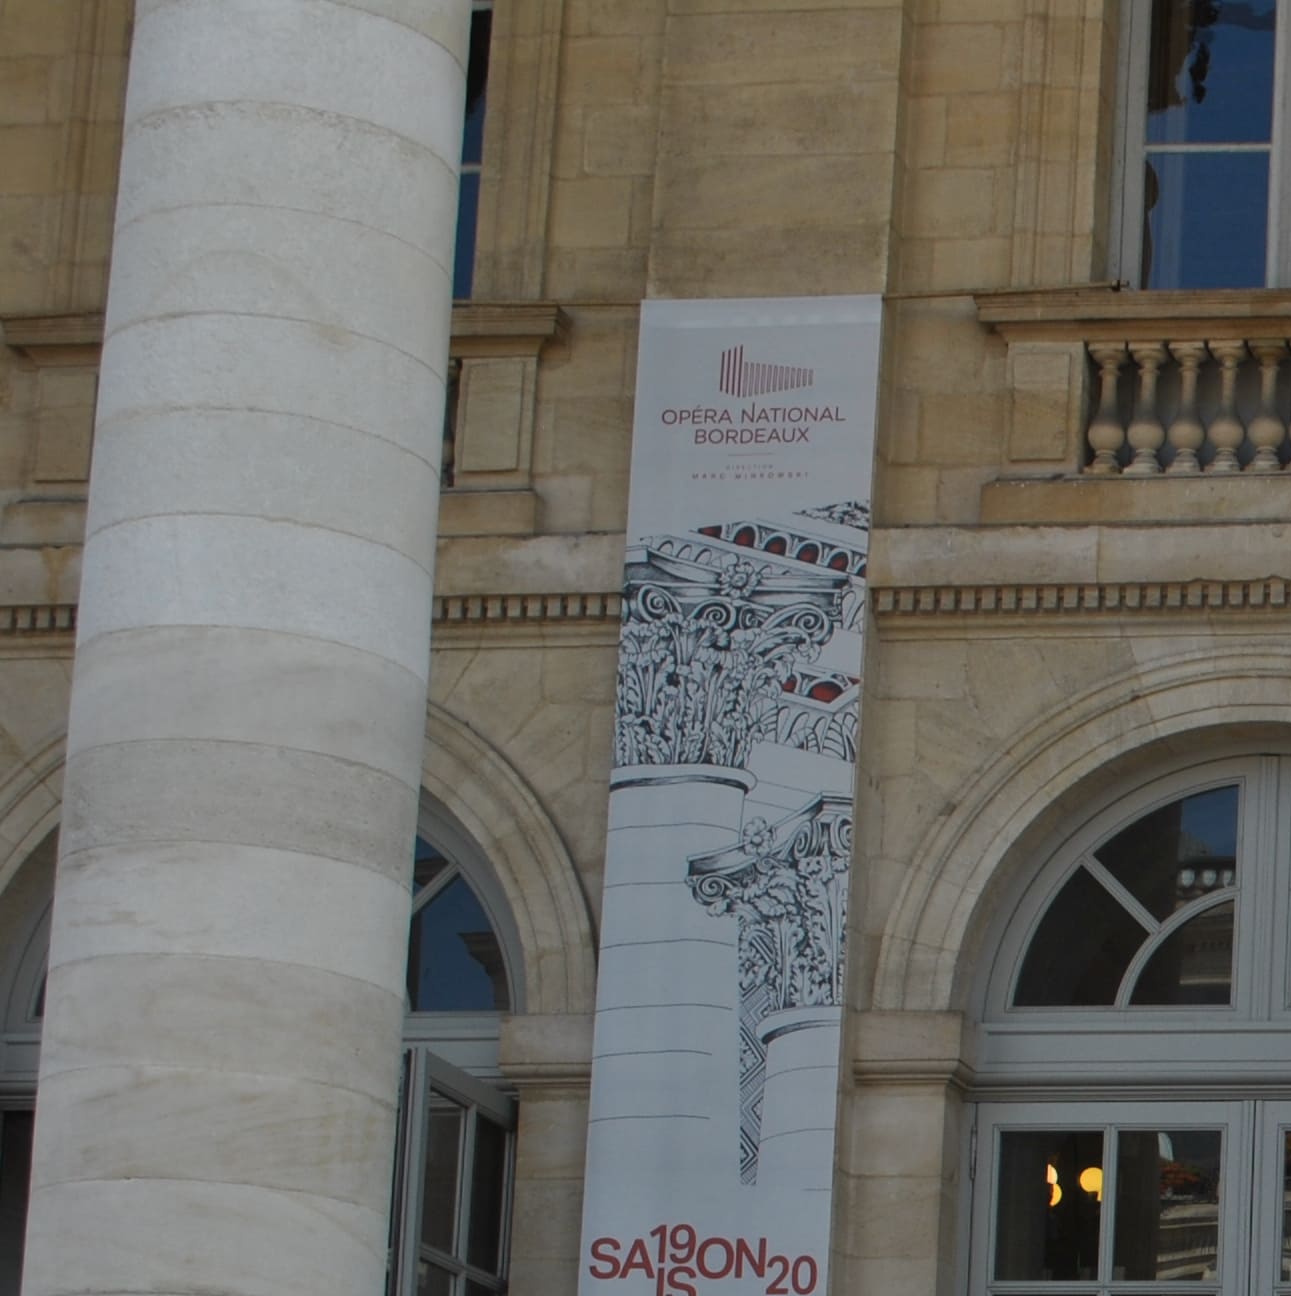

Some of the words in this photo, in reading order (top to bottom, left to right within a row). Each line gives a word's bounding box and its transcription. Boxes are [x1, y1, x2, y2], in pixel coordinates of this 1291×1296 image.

[661, 404, 733, 425] OPÉRA
[741, 402, 846, 424] NATIONAL
[694, 427, 810, 445] BORDEAUX
